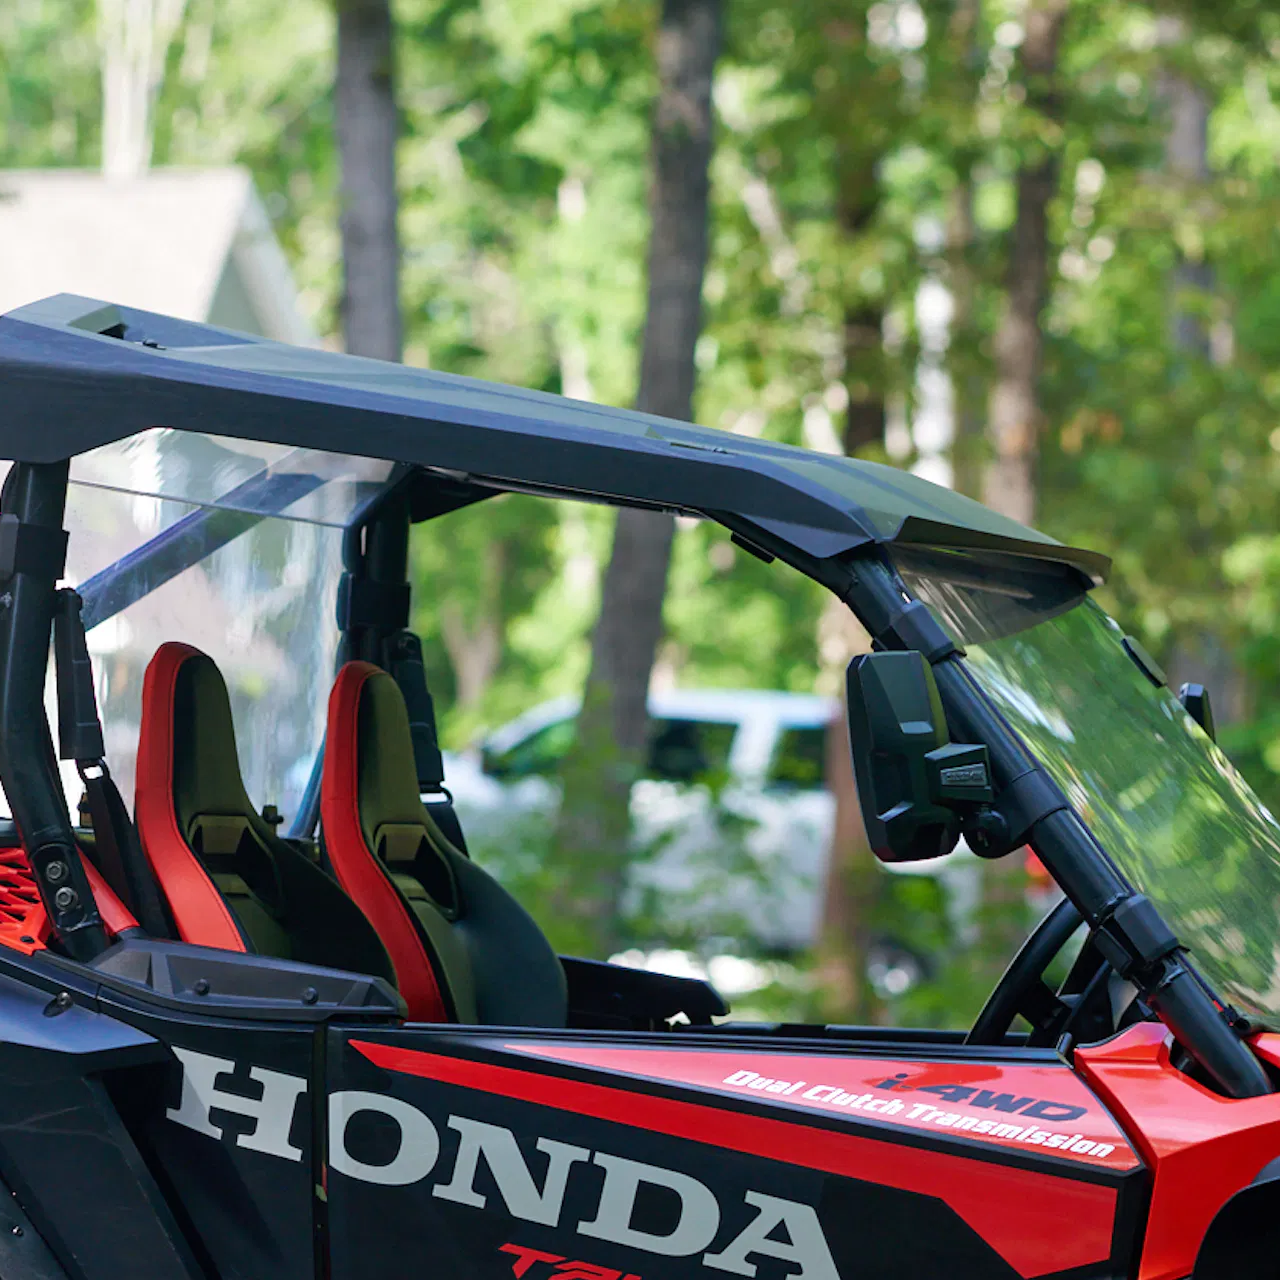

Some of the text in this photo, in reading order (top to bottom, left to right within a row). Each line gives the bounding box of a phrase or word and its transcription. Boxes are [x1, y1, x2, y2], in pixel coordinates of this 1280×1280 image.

[722, 1070, 1116, 1158] Dual Clutch Transmission
